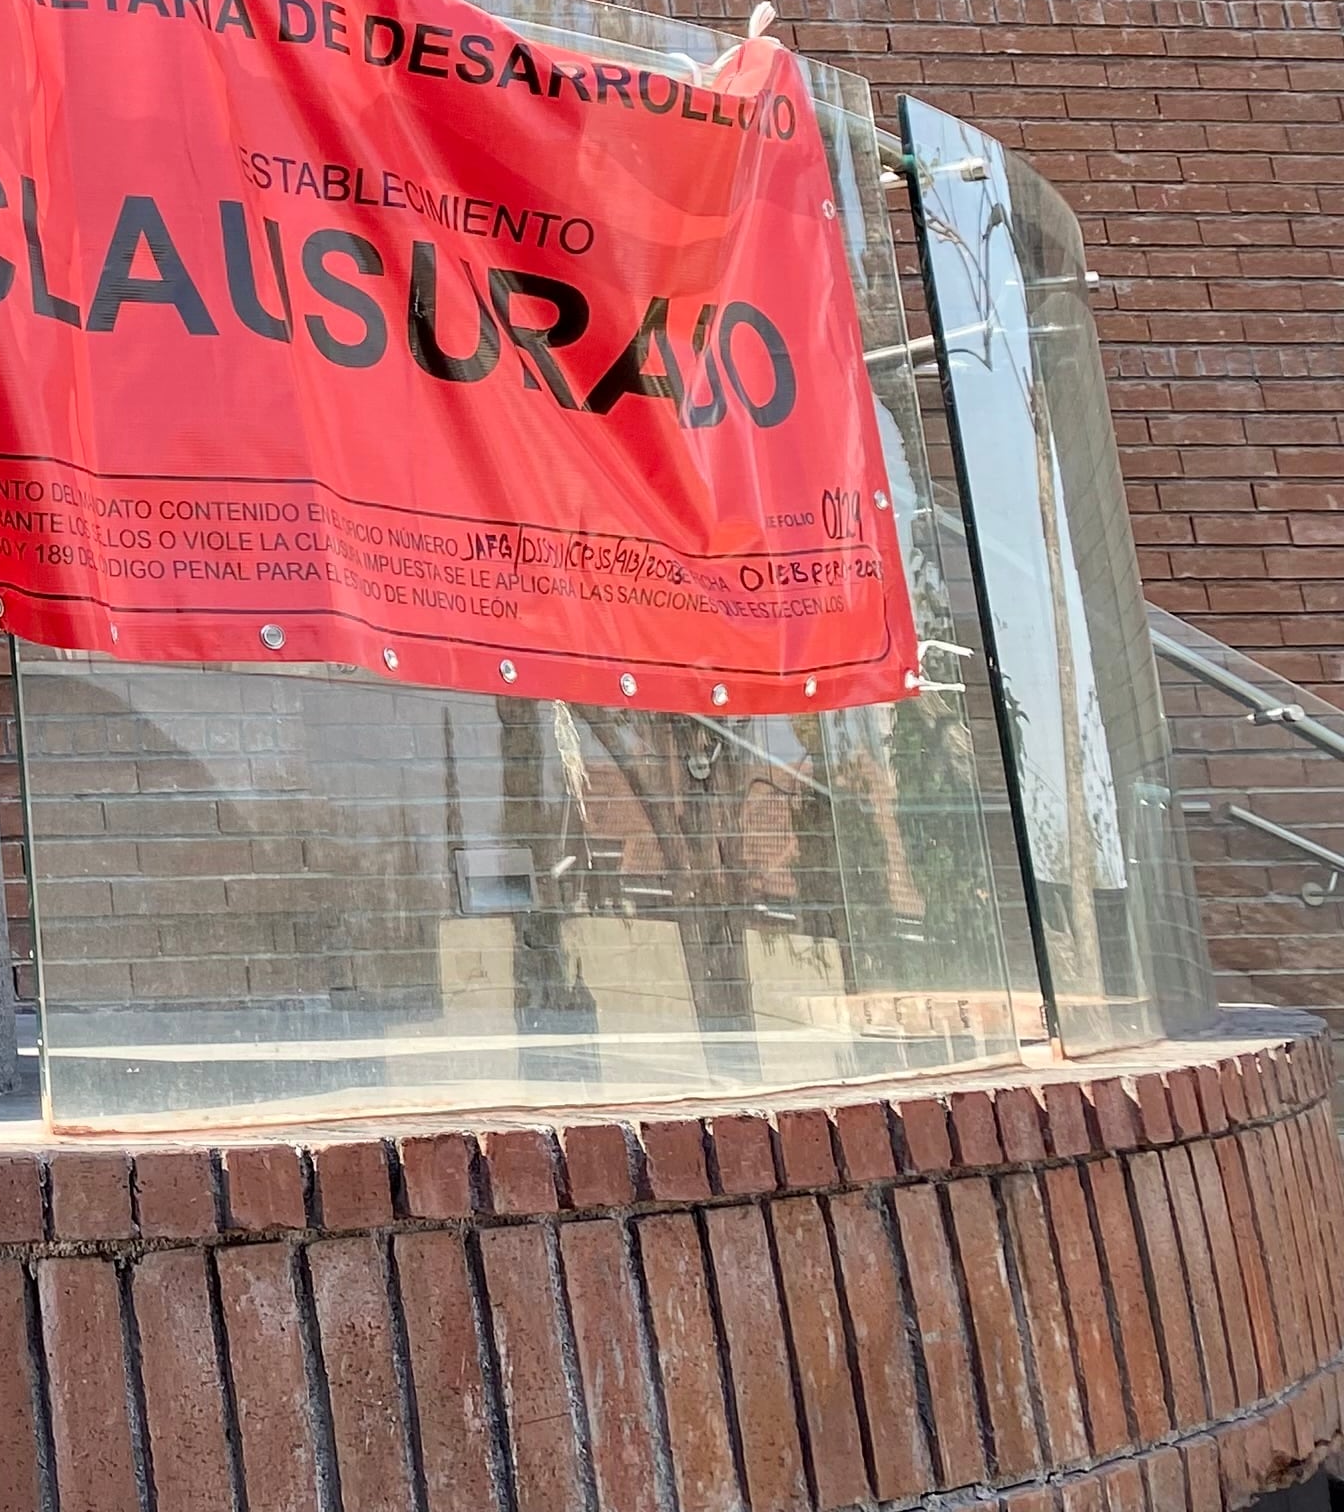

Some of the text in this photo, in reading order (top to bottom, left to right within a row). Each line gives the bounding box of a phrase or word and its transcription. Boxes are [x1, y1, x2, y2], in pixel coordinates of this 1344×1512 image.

[239, 148, 595, 255] ESTABLECIMIENTO
[159, 500, 300, 523] CONTENIDO
[388, 526, 459, 557] NÚMERO
[777, 512, 815, 528] FOLIO
[16, 542, 28, 561] Y
[34, 544, 74, 565] 189
[172, 559, 250, 581] PENAL
[256, 561, 322, 582] PARA
[385, 584, 408, 605] DE
[413, 586, 466, 613] NUEVO
[158, 529, 176, 550] O
[183, 530, 253, 551] VIOLE
[261, 532, 290, 552] LA
[363, 550, 441, 580] IMPUESTA
[444, 562, 466, 586] SE
[470, 567, 491, 589] LE
[580, 581, 613, 602] LAS
[617, 585, 718, 614] SANCIONES
[825, 595, 845, 613] LOS
